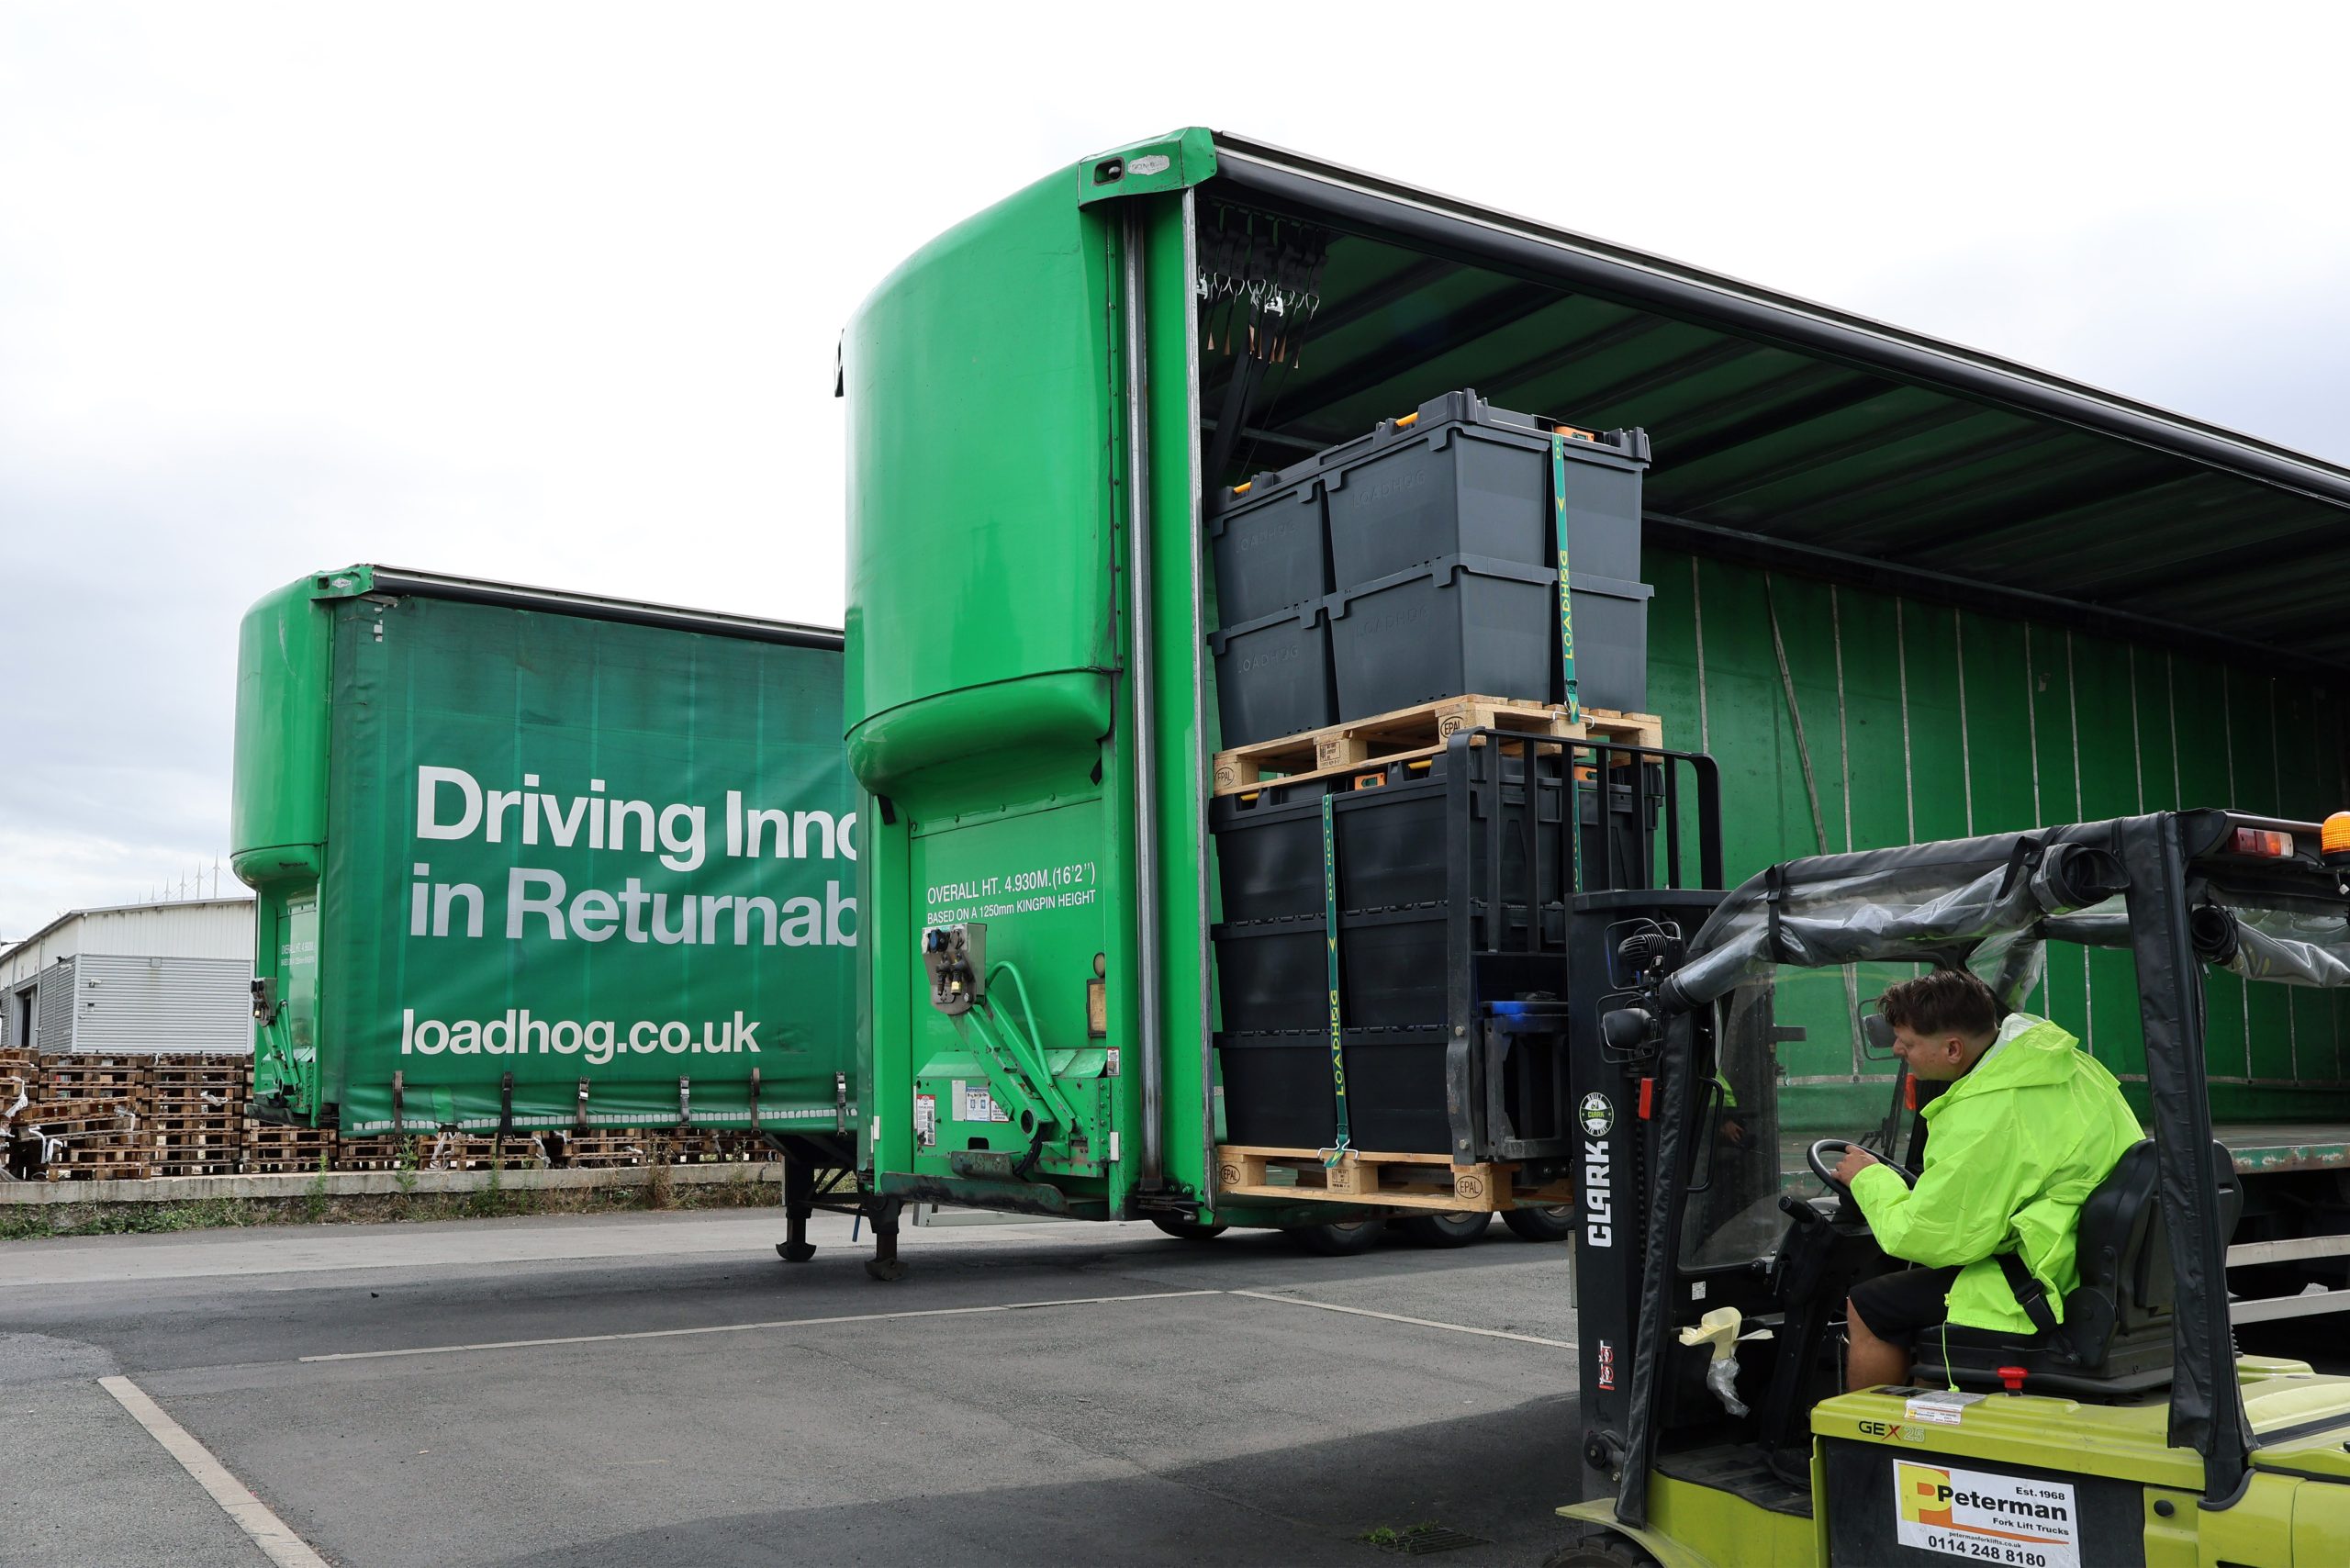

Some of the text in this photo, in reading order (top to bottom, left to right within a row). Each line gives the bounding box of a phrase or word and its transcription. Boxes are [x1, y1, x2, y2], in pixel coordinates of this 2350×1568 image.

[417, 765, 706, 871] Driving
[410, 862, 856, 947] in Returnab
[927, 880, 979, 904] OVERALL
[982, 877, 1001, 897] HT.
[927, 890, 1096, 925] BASED ON A 1250mm KINGPIN HEIGHT
[401, 1009, 761, 1065] loadhog.co.uk
[1224, 1169, 1237, 1181] EPAL
[1460, 1181, 1480, 1194] EPAL
[1584, 1140, 1612, 1248] CLARK
[1903, 1427, 1925, 1442] 25
[1937, 1484, 2067, 1522] Peterman
[1949, 1531, 2021, 1549] petermanforklifts.co.uk
[1993, 1518, 2069, 1536] Fork Lift Trucks
[1928, 1535, 2046, 1568] 0114 248 8180
